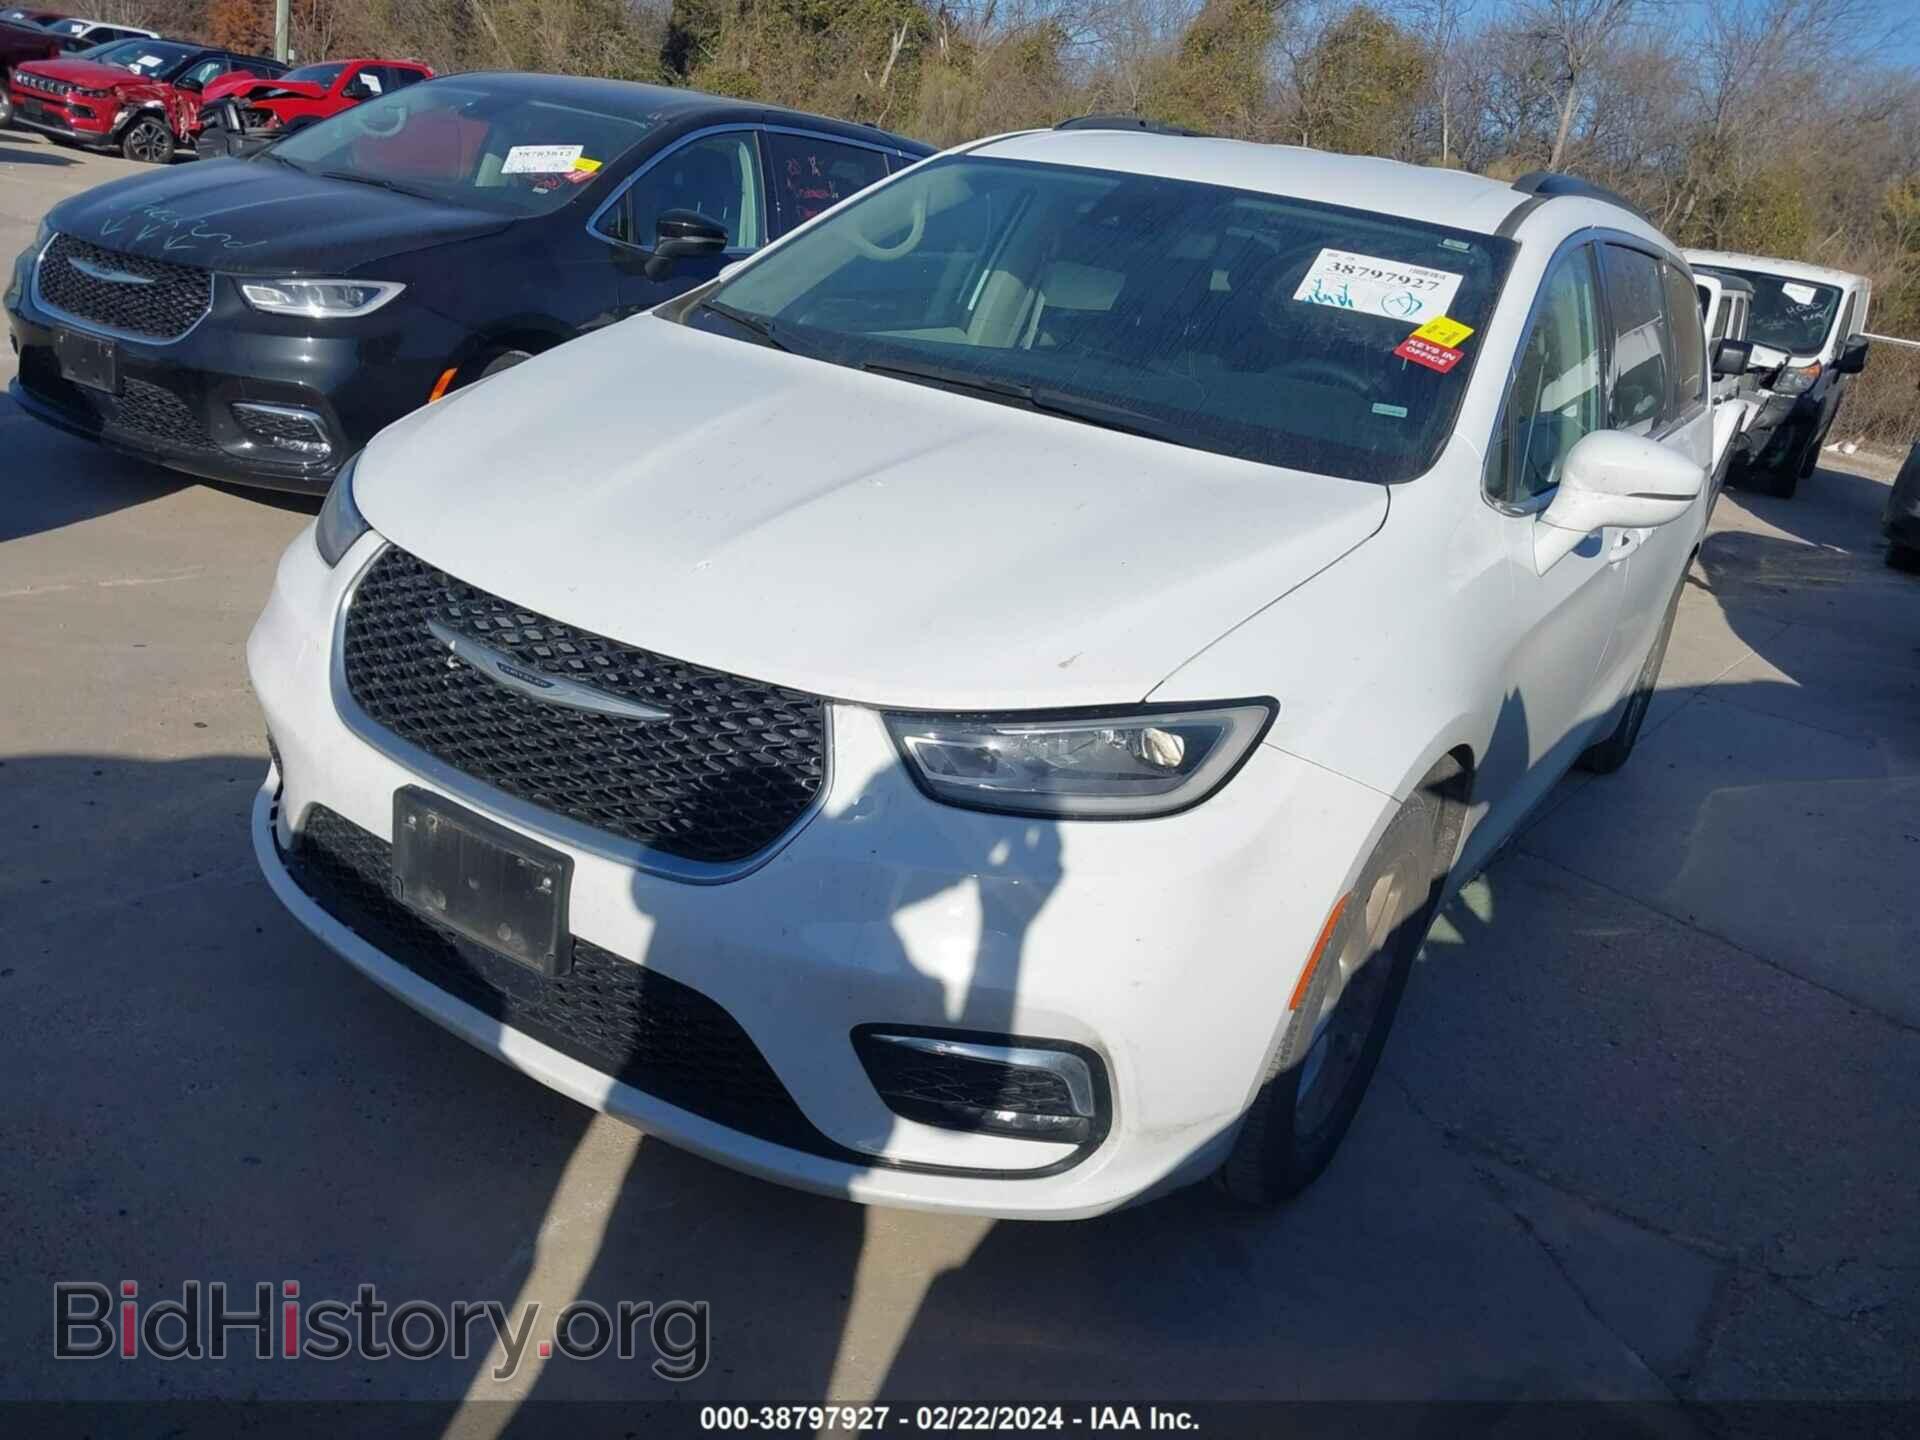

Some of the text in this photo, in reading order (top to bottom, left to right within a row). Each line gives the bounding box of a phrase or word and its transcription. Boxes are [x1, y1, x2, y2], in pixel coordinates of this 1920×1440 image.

[1326, 262, 1440, 291] 38797927
[1405, 346, 1448, 366] OFFICE
[1408, 340, 1457, 361] KEYS IN
